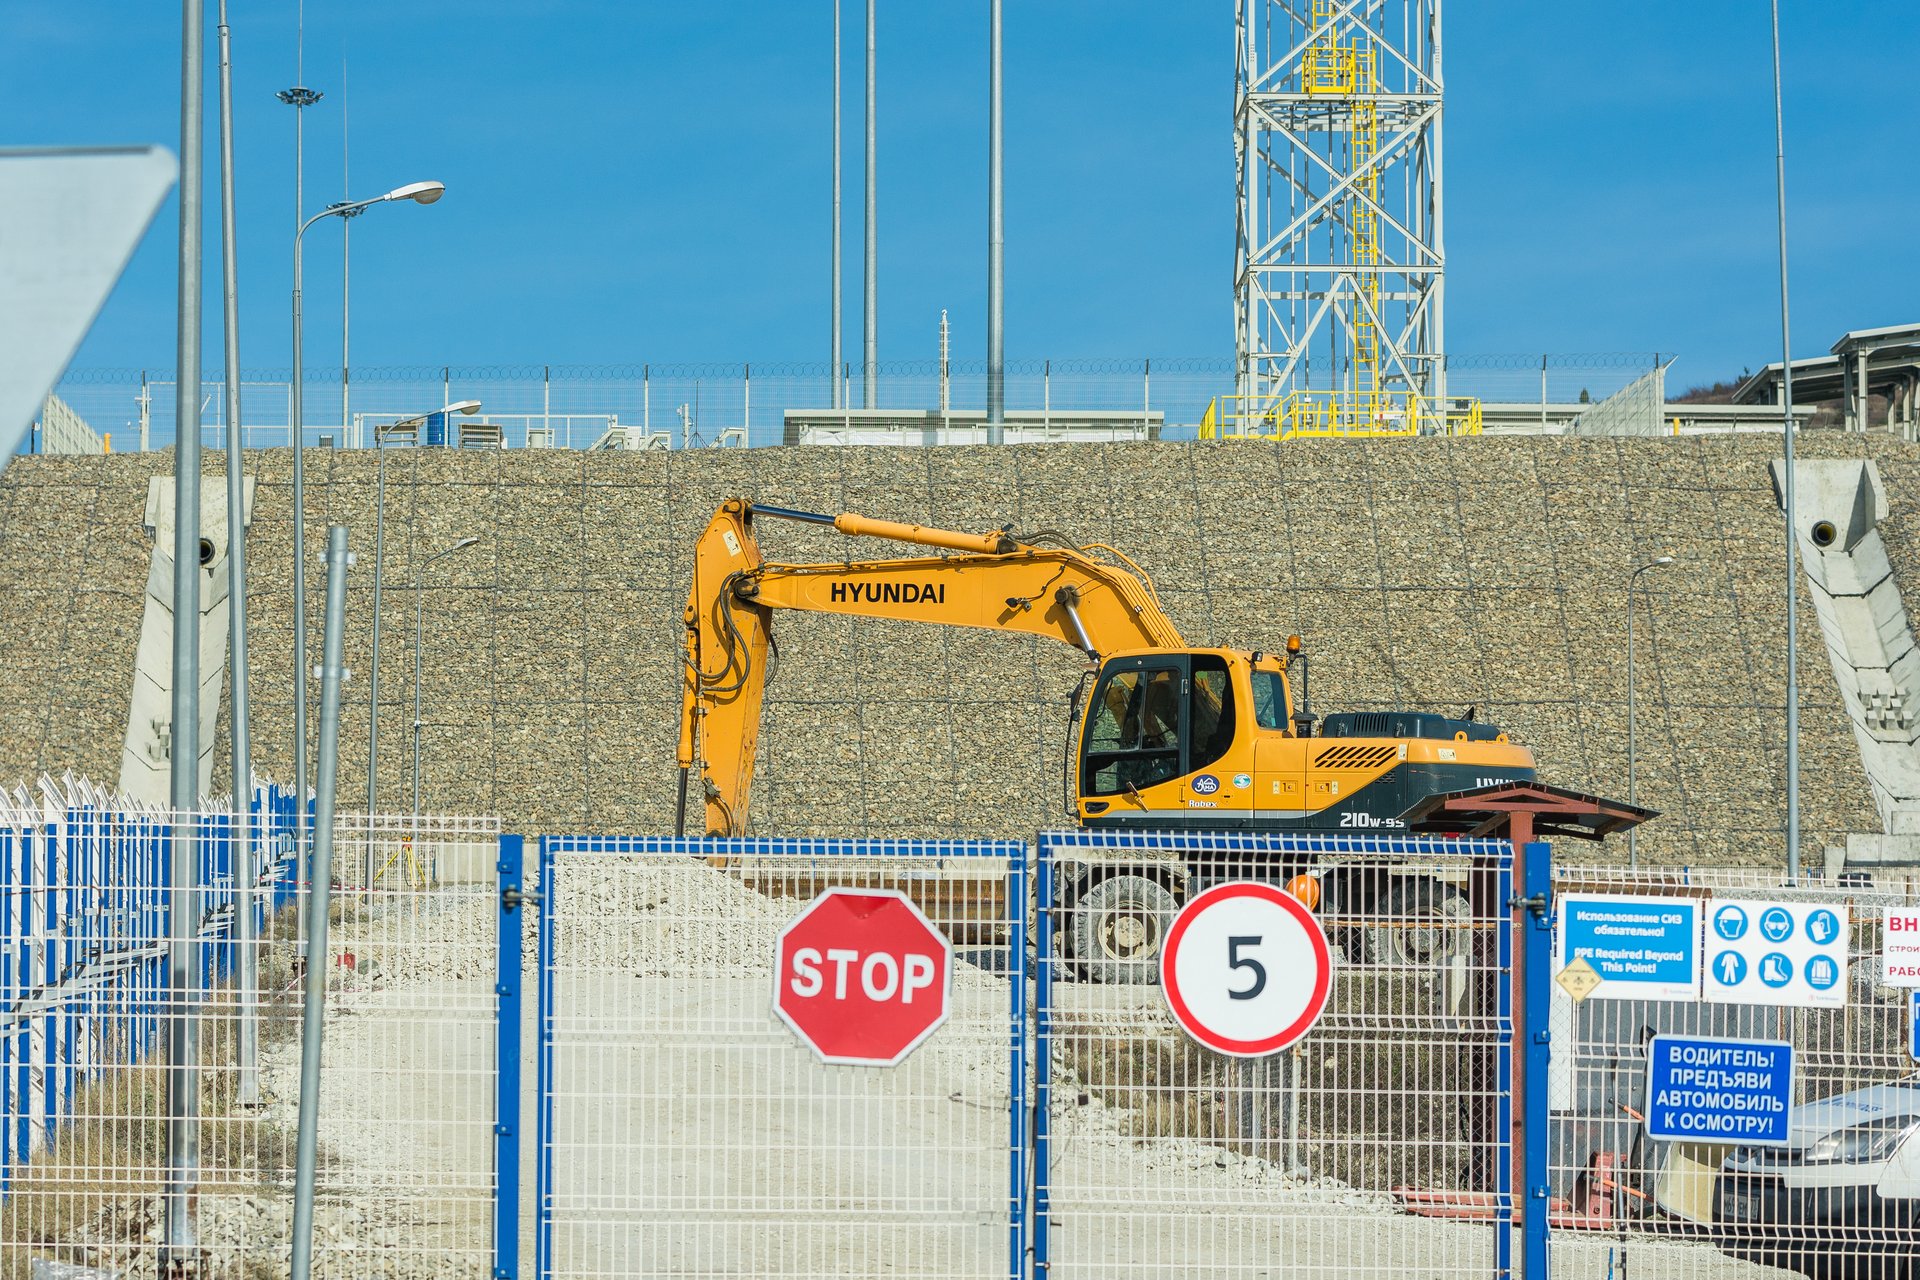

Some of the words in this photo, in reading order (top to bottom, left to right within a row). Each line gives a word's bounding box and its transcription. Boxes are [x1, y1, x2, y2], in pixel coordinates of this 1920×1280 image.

[831, 582, 945, 603] HYUNDAI
[1189, 800, 1217, 808] Robex
[1576, 911, 1659, 924] Использование
[1661, 914, 1682, 925] СИЗ
[1890, 917, 1918, 932] ВН
[1594, 924, 1665, 937] обязательно!
[1574, 947, 1594, 959] PPE
[1595, 948, 1642, 961] Required
[1644, 950, 1684, 962] Beyond
[790, 947, 935, 1004] STOP
[1228, 936, 1266, 1000] 5
[1601, 962, 1623, 972] This
[1625, 962, 1656, 973] Point!
[1669, 1046, 1774, 1068] ВОДИТЕЛЬ!
[1670, 1068, 1771, 1090] ПРЕДЪЯВИ
[1656, 1089, 1784, 1112] АВТОМОБИЛЬ
[1664, 1112, 1675, 1128] К
[1680, 1112, 1773, 1134] ОСМОТРУ!
